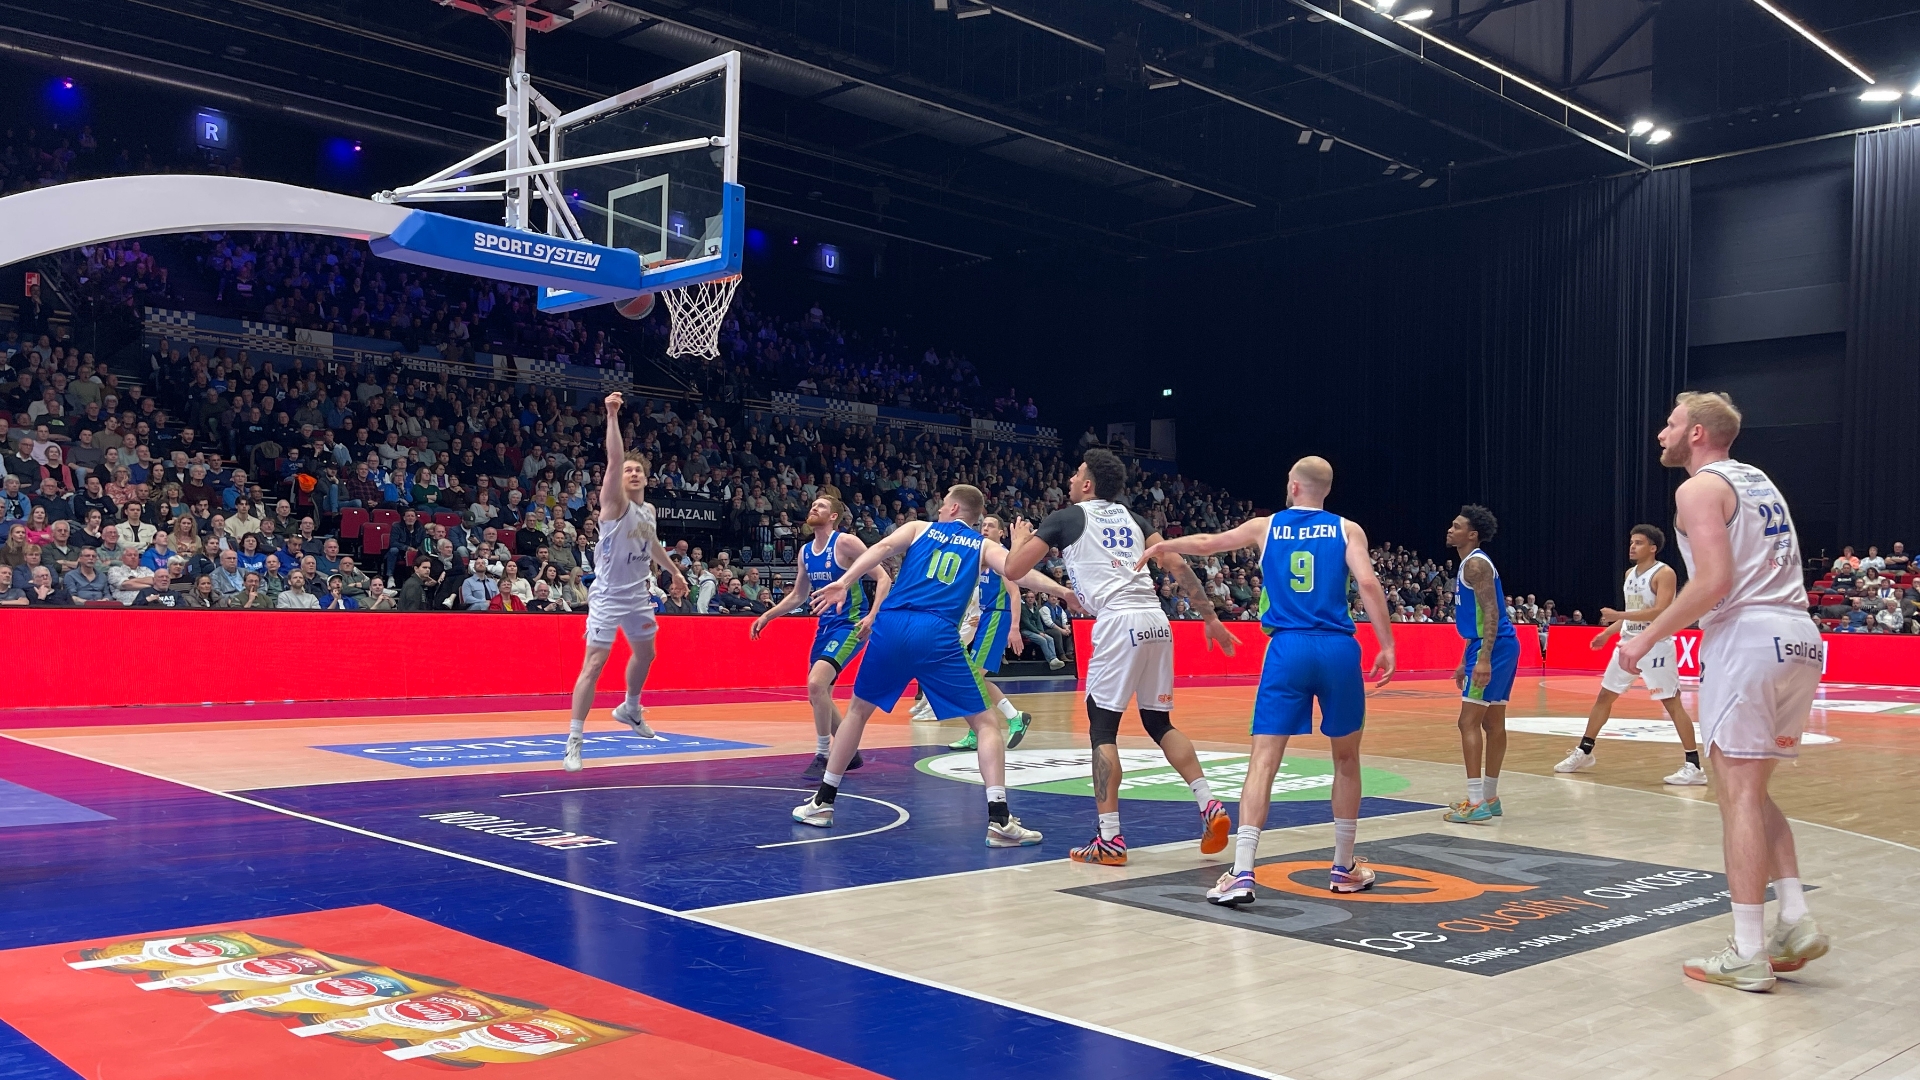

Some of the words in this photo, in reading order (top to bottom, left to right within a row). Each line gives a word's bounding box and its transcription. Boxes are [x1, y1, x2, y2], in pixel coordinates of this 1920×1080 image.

[206, 122, 219, 141] R
[675, 223, 684, 237] T
[474, 232, 533, 254] SPORT
[533, 243, 601, 268] SYSTEM
[825, 254, 835, 268] U
[1758, 503, 1790, 537] 22
[1102, 526, 1134, 549] 33
[1272, 526, 1295, 540] V.D.
[1298, 524, 1337, 540] ELZEN
[926, 548, 962, 585] 10
[1290, 551, 1314, 593] 9
[1651, 656, 1666, 669] 11
[418, 811, 618, 850] EXCEPTION
[1334, 930, 1447, 953] be
[1437, 895, 1609, 934] quality
[1583, 868, 1714, 902] aware
[1445, 946, 1520, 966] TESTING
[1520, 933, 1573, 949] DATA
[404, 1000, 455, 1022] Marne
[492, 1022, 551, 1044] Marne
